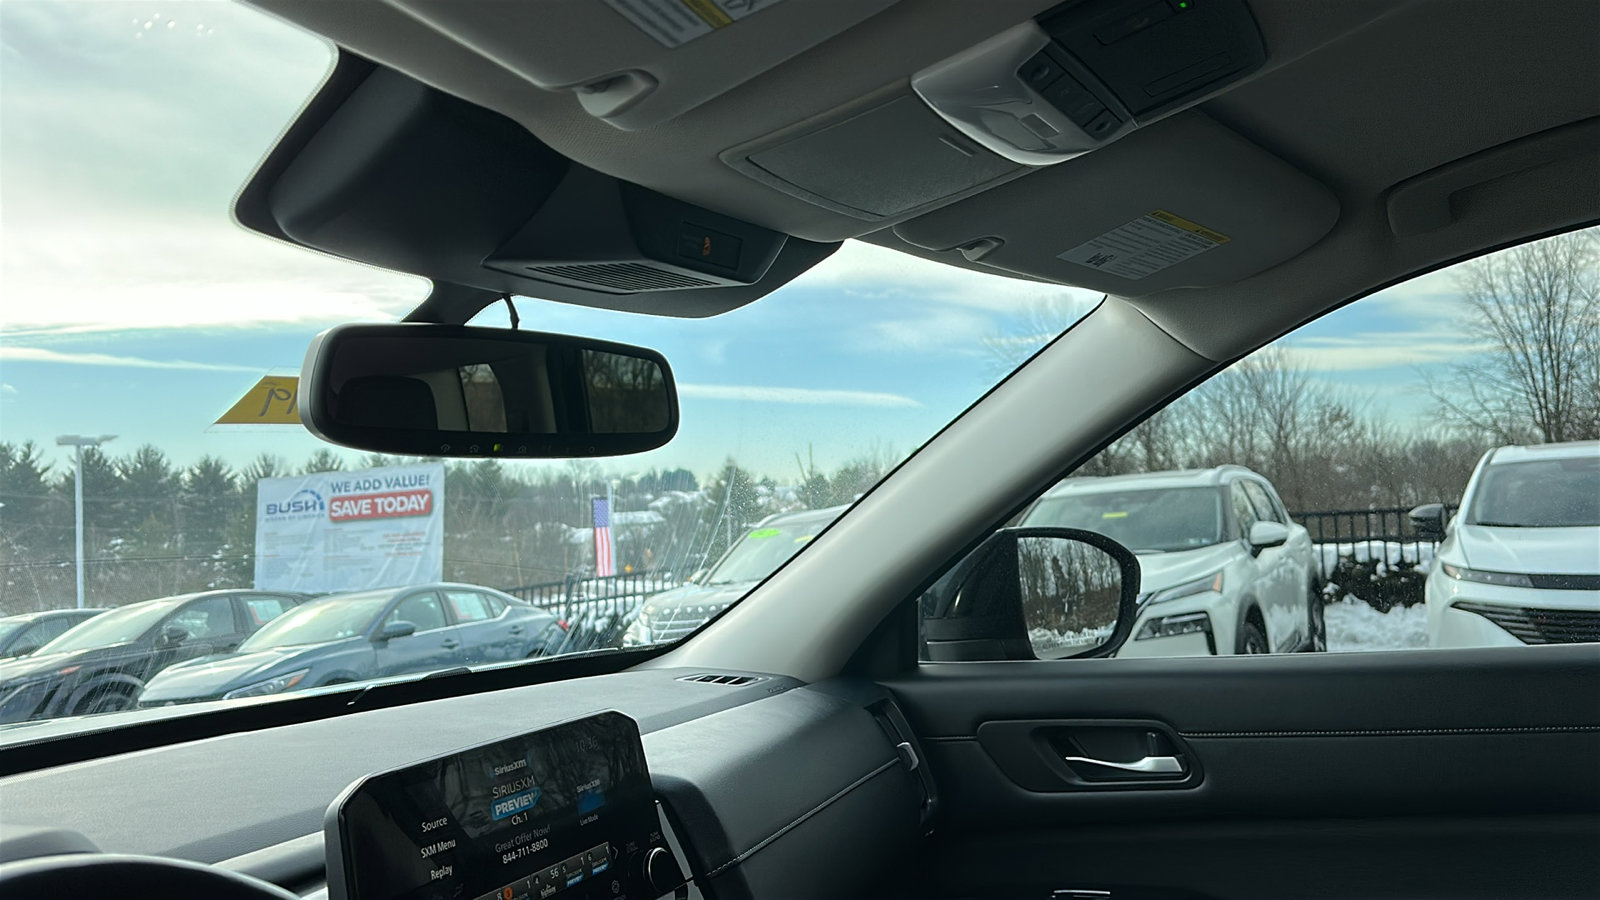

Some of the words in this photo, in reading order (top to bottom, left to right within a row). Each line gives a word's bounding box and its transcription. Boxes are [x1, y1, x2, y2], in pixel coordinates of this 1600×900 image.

[331, 481, 350, 493] WE
[354, 478, 381, 491] ADD
[385, 474, 430, 489] VALUE!
[266, 501, 317, 515] BUSH
[330, 499, 371, 517] SAVE
[374, 493, 429, 513] TODAY
[421, 817, 448, 833] Source
[523, 812, 529, 821] 1
[420, 844, 437, 859] SXM
[437, 839, 456, 853] Menu
[495, 839, 514, 853] Great
[514, 831, 532, 846] Offer
[502, 839, 549, 864] 844-711-8800
[430, 864, 453, 880] Replay
[550, 867, 560, 879] 56
